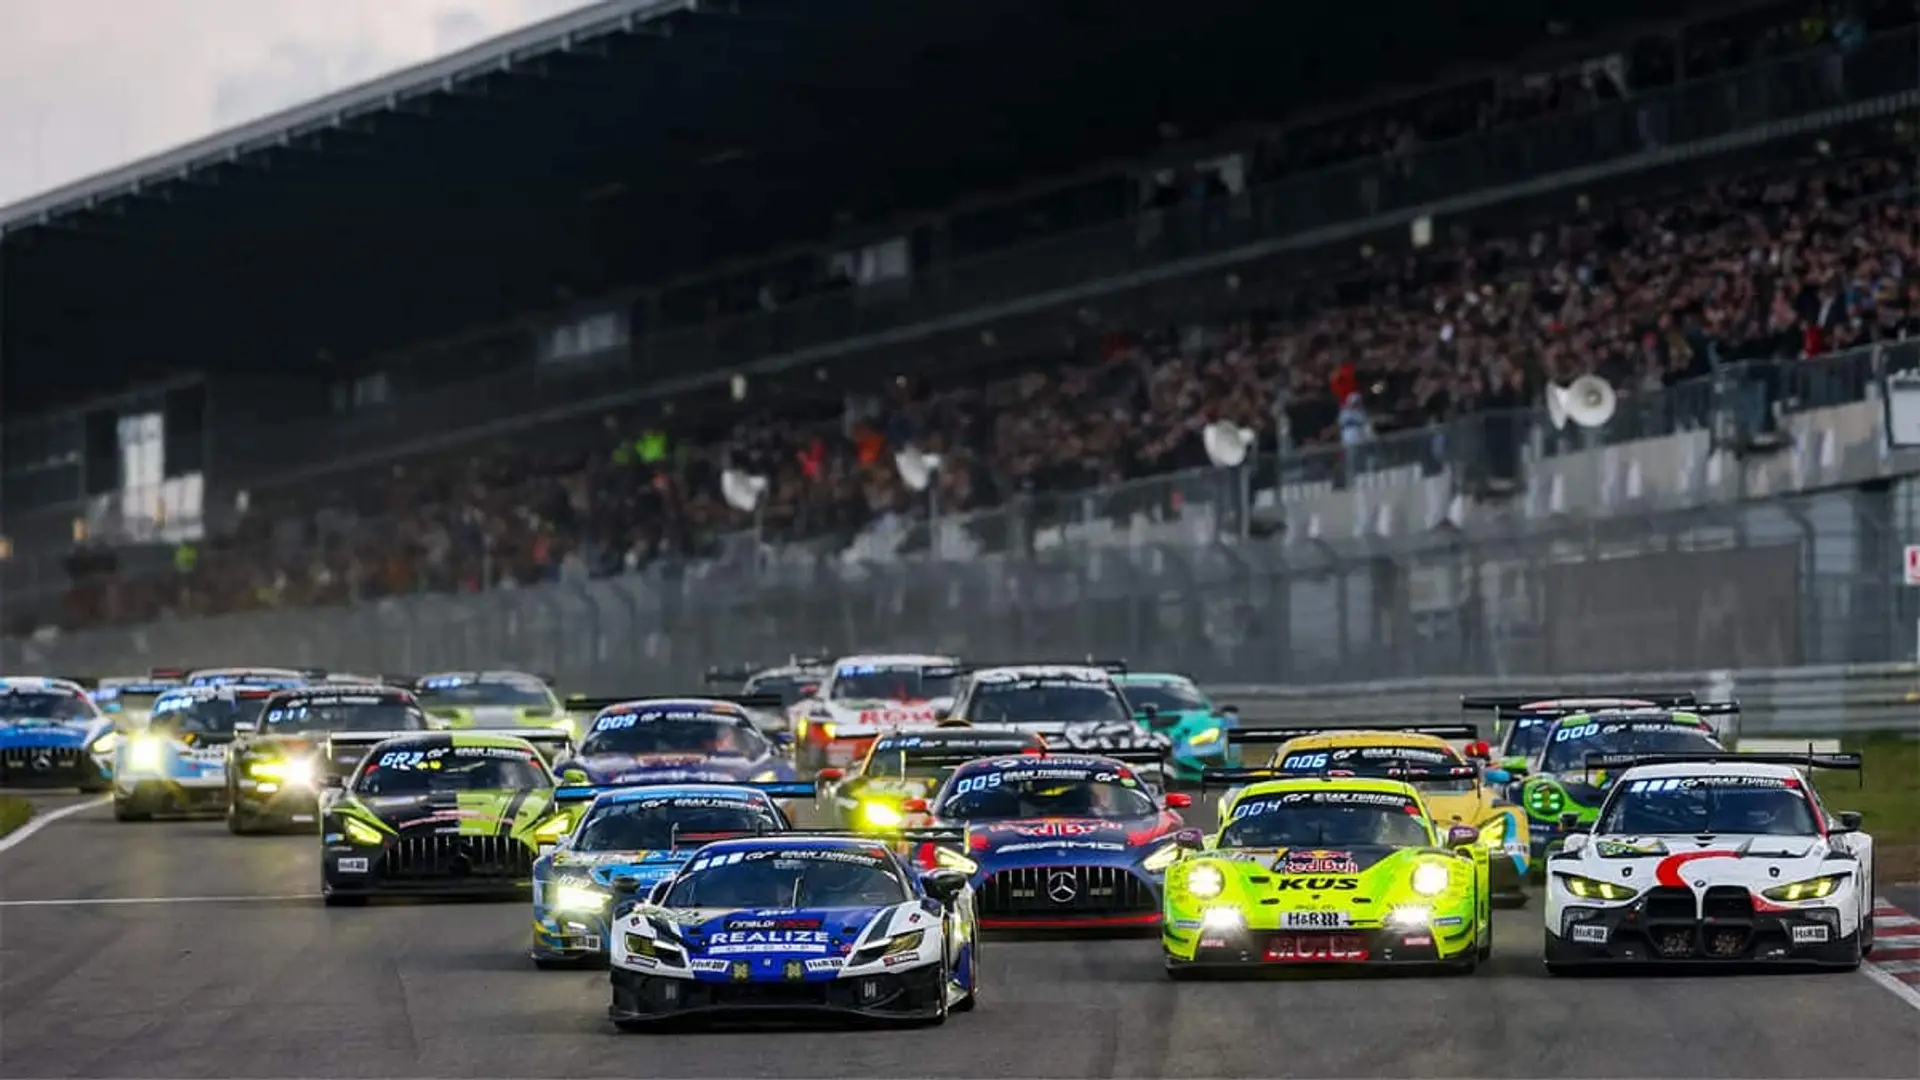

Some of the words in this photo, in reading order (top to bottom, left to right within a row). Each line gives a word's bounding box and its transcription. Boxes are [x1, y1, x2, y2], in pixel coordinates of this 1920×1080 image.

[597, 713, 637, 731] 009
[1556, 723, 1600, 742] 000
[1002, 770, 1034, 781] GRAN
[956, 773, 1002, 794] 005
[674, 799, 711, 808] GRAN
[1312, 792, 1349, 803] GRAN
[1233, 800, 1282, 818] 004
[779, 850, 817, 860] GRAN
[1283, 859, 1318, 873] Red
[1320, 858, 1358, 874] Bull
[1278, 877, 1359, 891] KÜS
[1287, 912, 1319, 926] H&R
[709, 930, 829, 945] REALIZE
